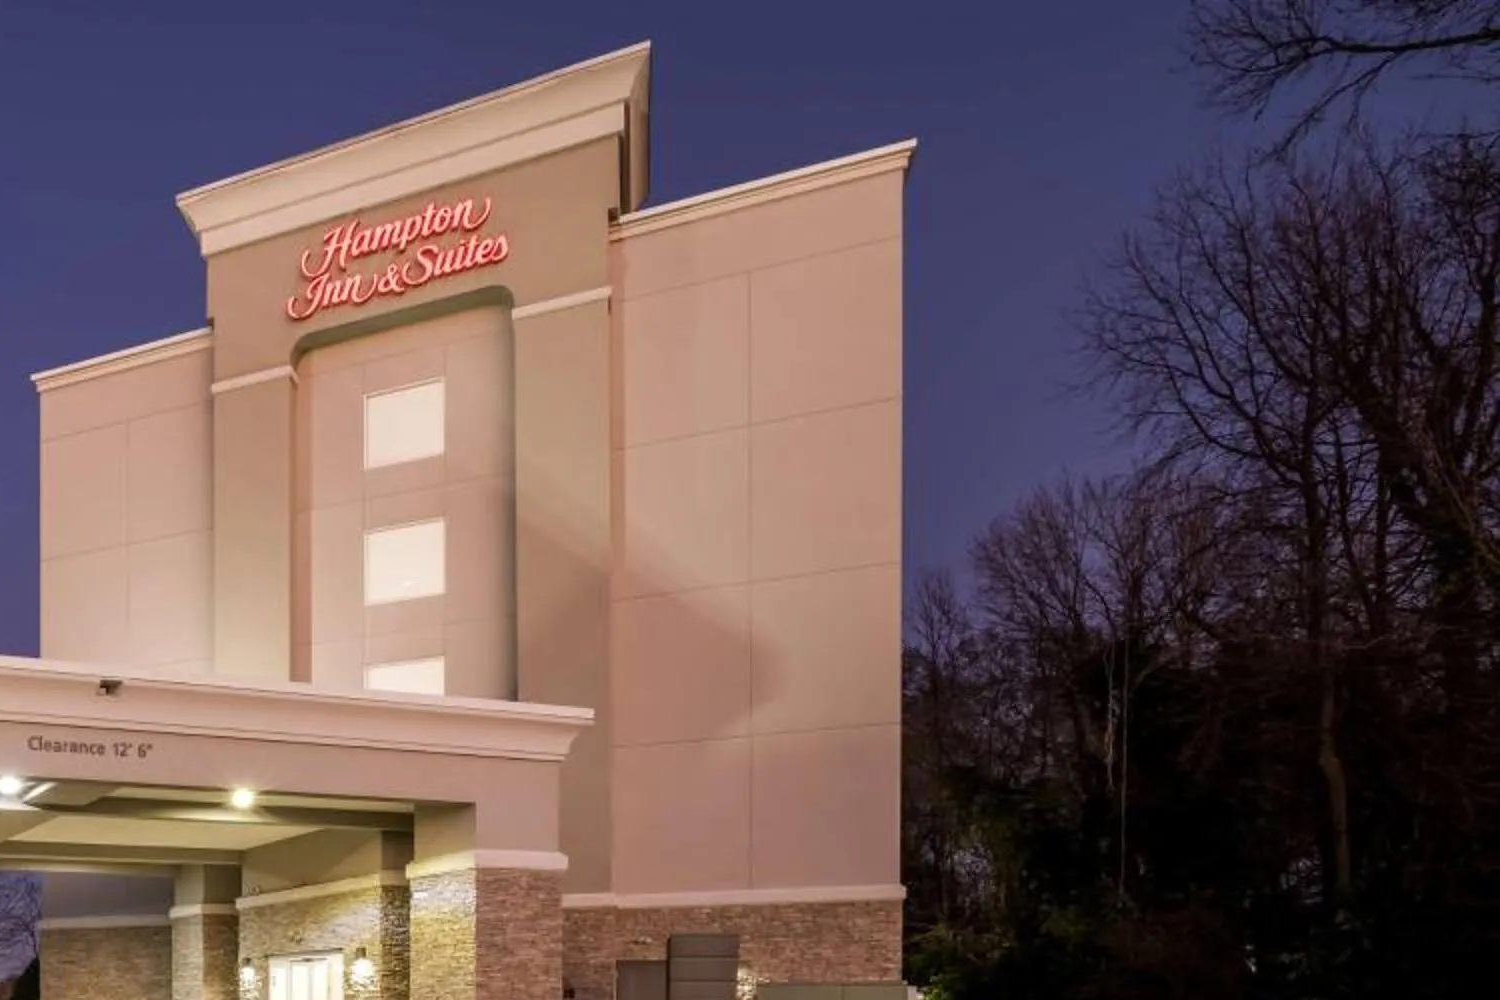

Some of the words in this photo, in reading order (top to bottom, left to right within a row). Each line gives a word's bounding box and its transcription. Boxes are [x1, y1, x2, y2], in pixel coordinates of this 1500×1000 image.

[286, 272, 378, 320] Inn
[377, 263, 405, 294] &
[401, 234, 509, 286] Suites
[301, 197, 491, 278] Hampton
[27, 735, 106, 756] Clearance
